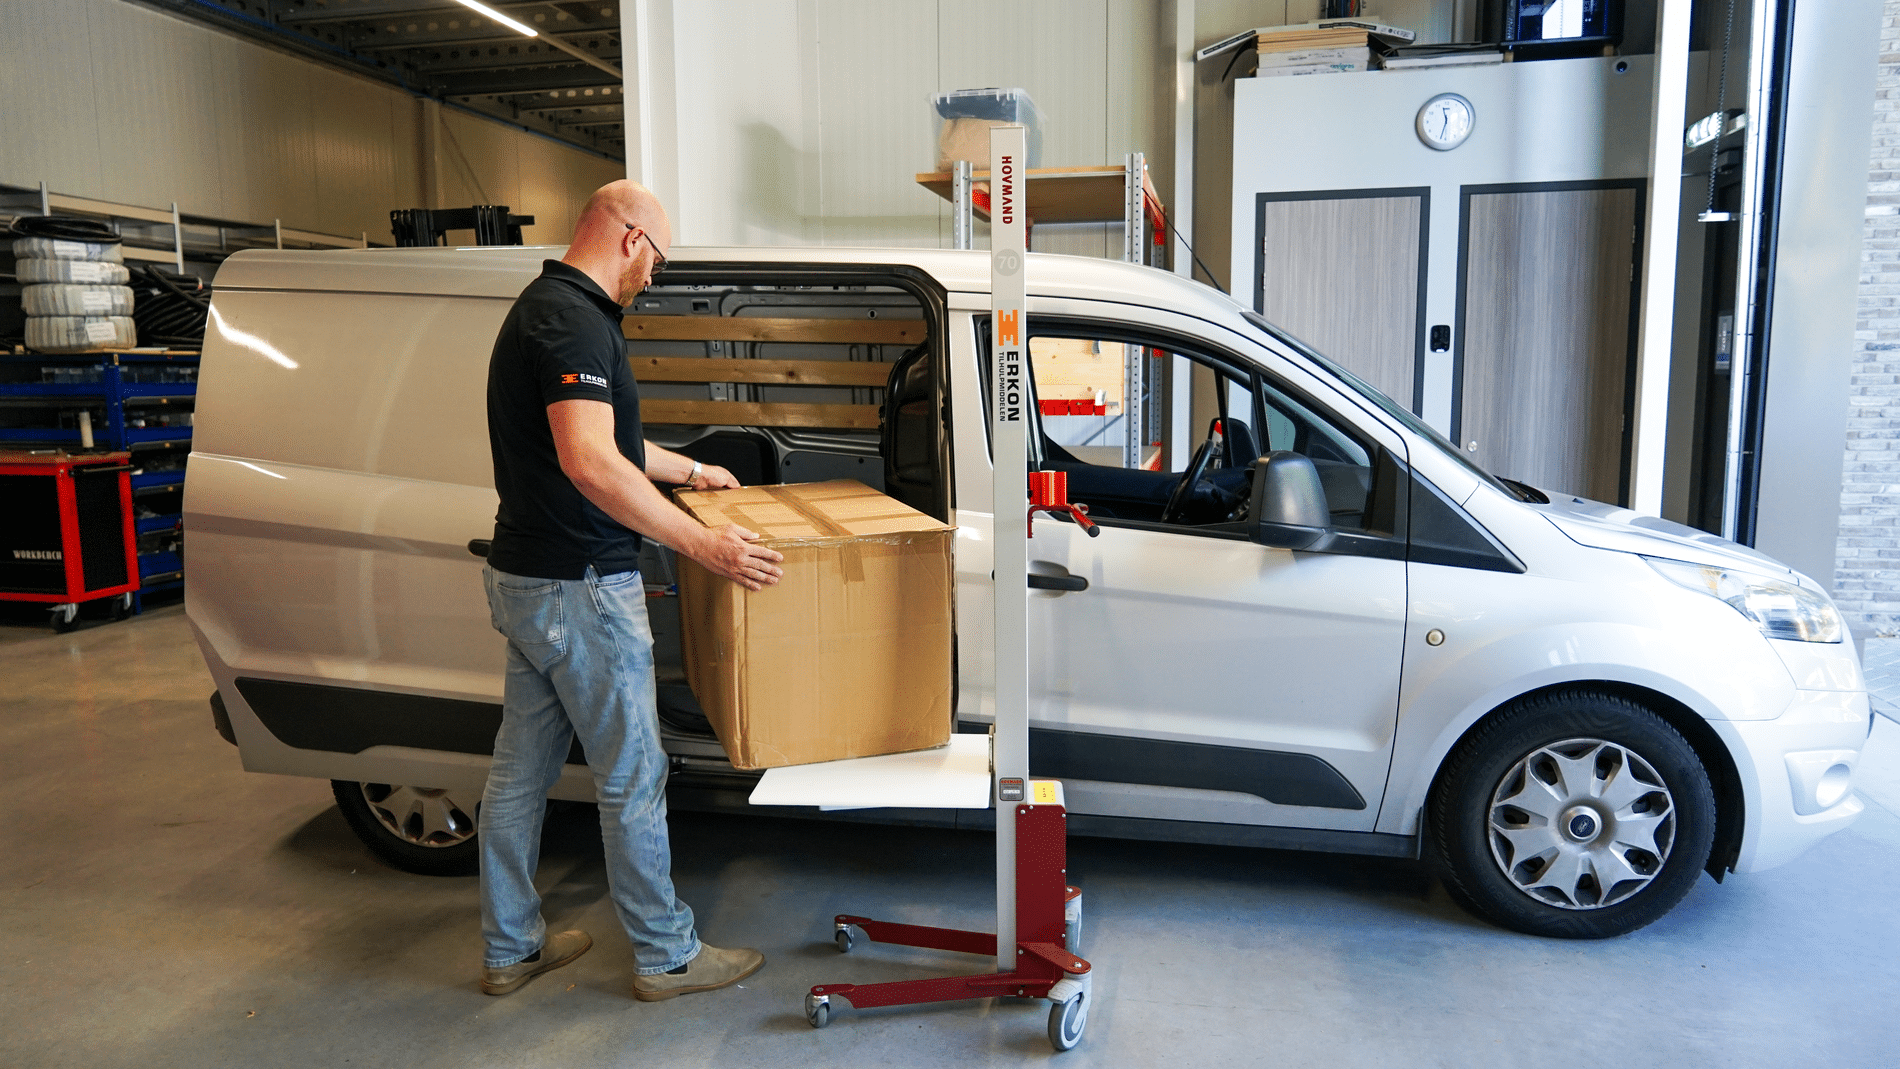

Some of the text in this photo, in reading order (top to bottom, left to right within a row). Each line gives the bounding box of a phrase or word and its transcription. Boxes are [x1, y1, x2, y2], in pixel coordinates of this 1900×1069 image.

[1002, 156, 1013, 224] HOVMAND
[998, 256, 1018, 270] 70
[580, 373, 607, 385] ERKON
[1007, 351, 1020, 421] ERKON
